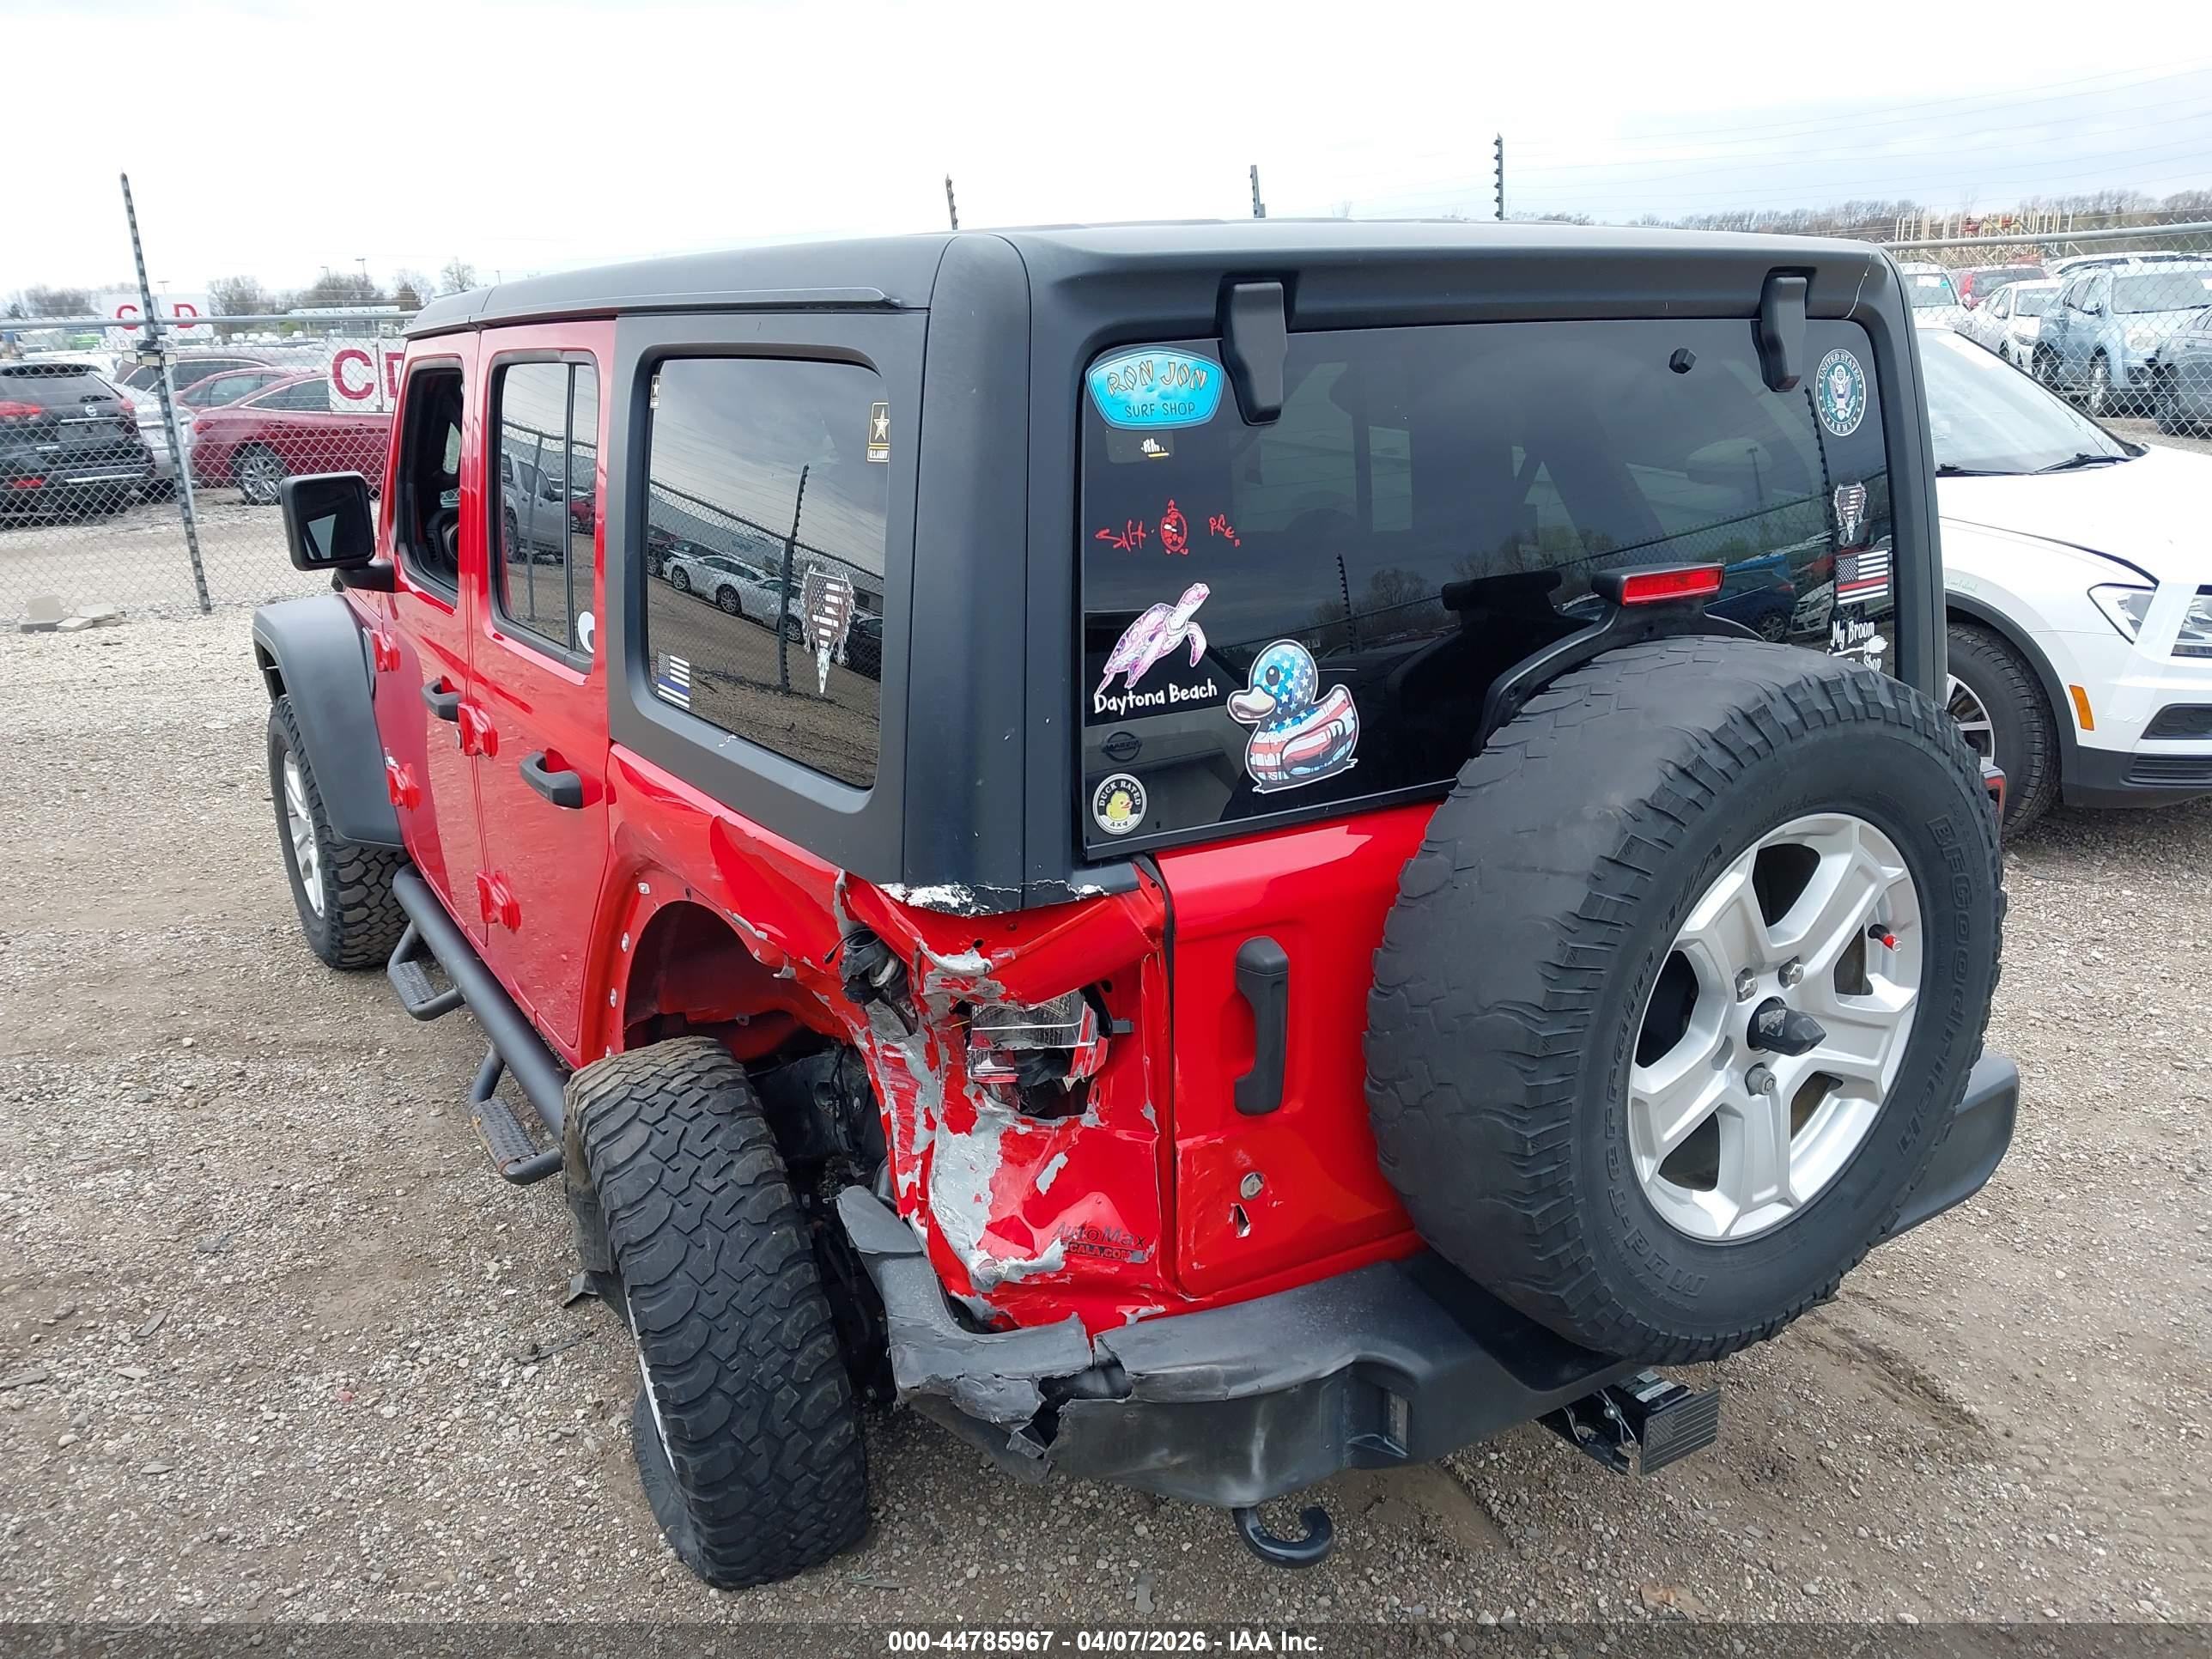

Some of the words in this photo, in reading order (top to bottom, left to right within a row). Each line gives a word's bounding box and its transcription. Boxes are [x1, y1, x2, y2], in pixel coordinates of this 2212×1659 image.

[1107, 360, 1154, 398] RON
[1160, 361, 1208, 391] JON
[1820, 353, 1840, 380] UNITED
[1840, 353, 1861, 381] STATES
[1124, 403, 1155, 418] SURF
[1162, 401, 1196, 416] SHOP
[1830, 420, 1853, 432] ARMY
[1830, 619, 1845, 651] My
[1848, 619, 1875, 644] Broom
[1863, 653, 1882, 672] Shop
[1094, 690, 1165, 716] Daytona
[1169, 678, 1218, 703] Beach
[1098, 781, 1118, 807] DUCK
[1120, 780, 1142, 805] RATED
[1896, 813, 1972, 1156] BFGoodrich
